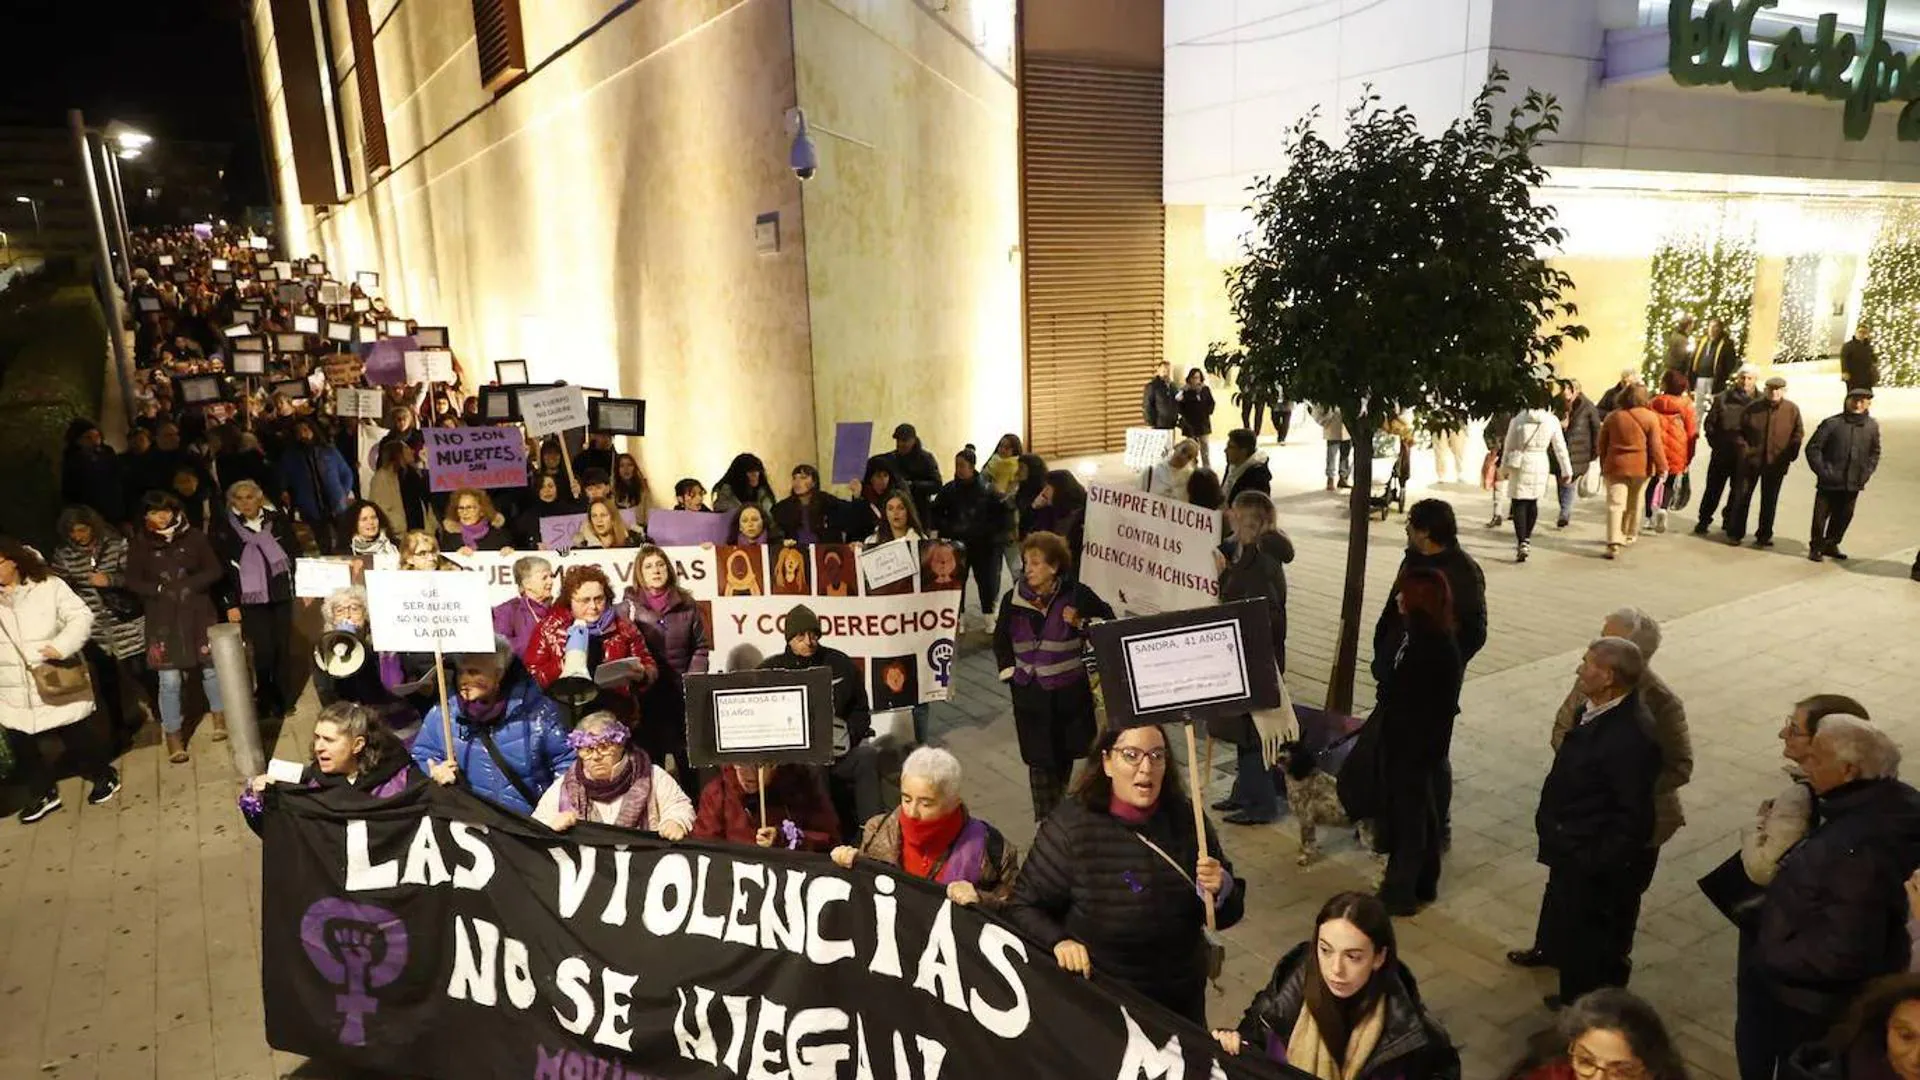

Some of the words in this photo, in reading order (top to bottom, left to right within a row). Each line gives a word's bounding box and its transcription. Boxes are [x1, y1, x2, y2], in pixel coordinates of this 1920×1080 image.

[433, 433, 464, 445] NO
[469, 430, 505, 442] SON
[1089, 486, 1149, 515] SIEMPRE
[1151, 500, 1168, 520] EN
[1170, 505, 1214, 533] LUCHA
[1117, 524, 1160, 548] CONTRA
[1163, 537, 1183, 555] LAS
[1147, 560, 1221, 597] MACHISTAS
[402, 601, 425, 611] SER
[413, 627, 430, 638] LA
[731, 614, 748, 634] Y
[757, 614, 788, 635] CO
[818, 608, 956, 636] DERECHOS
[1134, 640, 1180, 655] SANDRA,
[1184, 636, 1197, 647] 41
[1199, 630, 1229, 644] AÑOS
[344, 814, 496, 892] LAS
[447, 914, 537, 1010] NO
[552, 956, 640, 1051] SE
